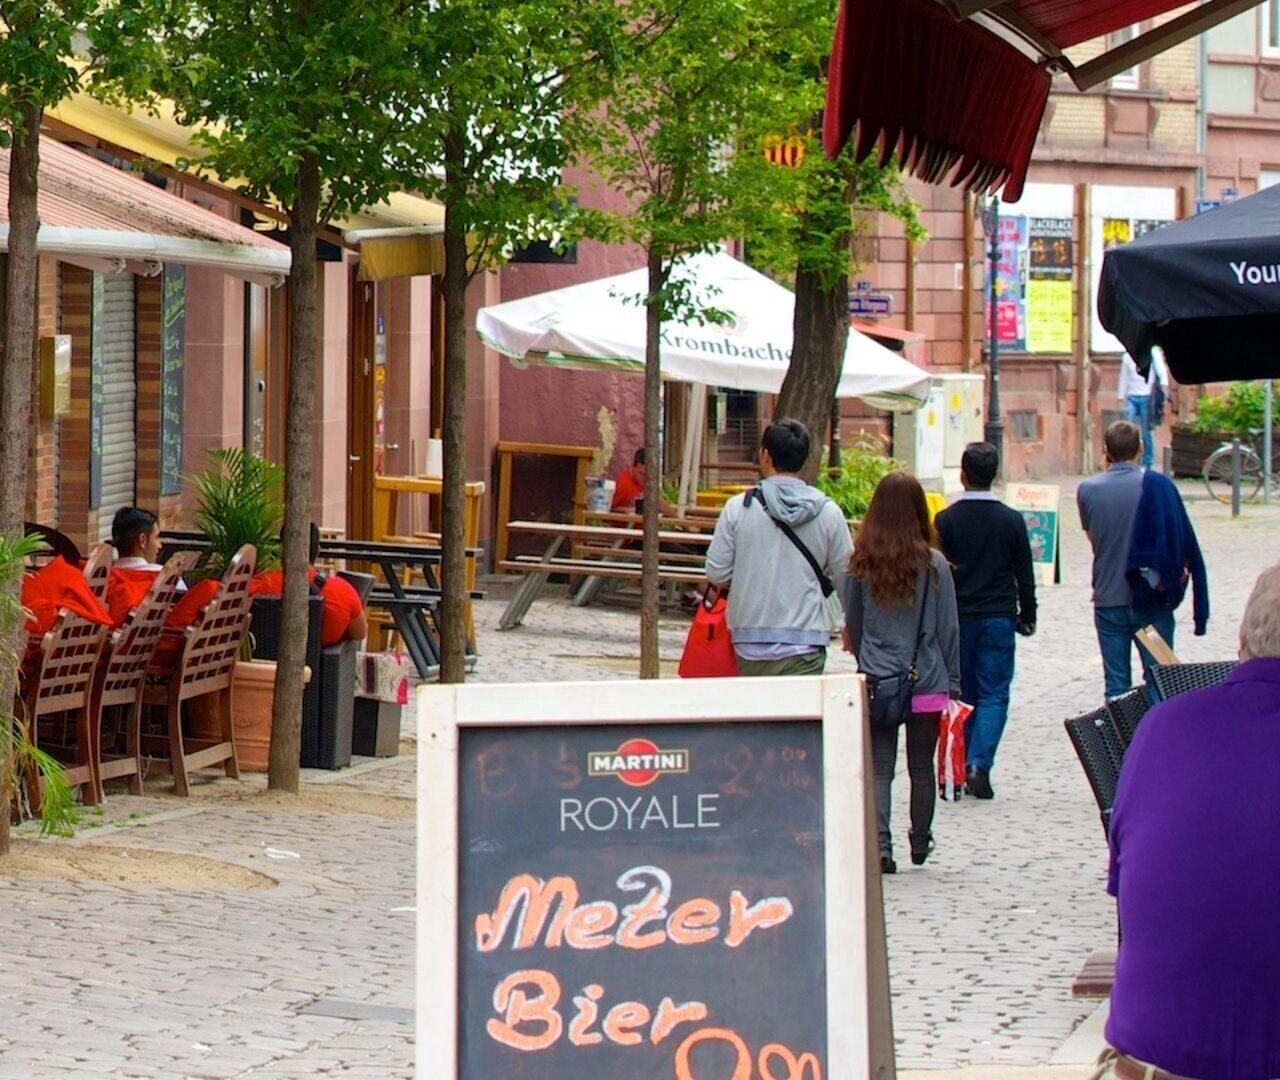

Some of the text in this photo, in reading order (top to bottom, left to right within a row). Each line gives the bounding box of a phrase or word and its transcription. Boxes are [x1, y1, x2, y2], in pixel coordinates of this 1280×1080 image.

[593, 751, 684, 772] MARTINI
[559, 793, 721, 832] ROYALE
[486, 969, 708, 1052] Bier
